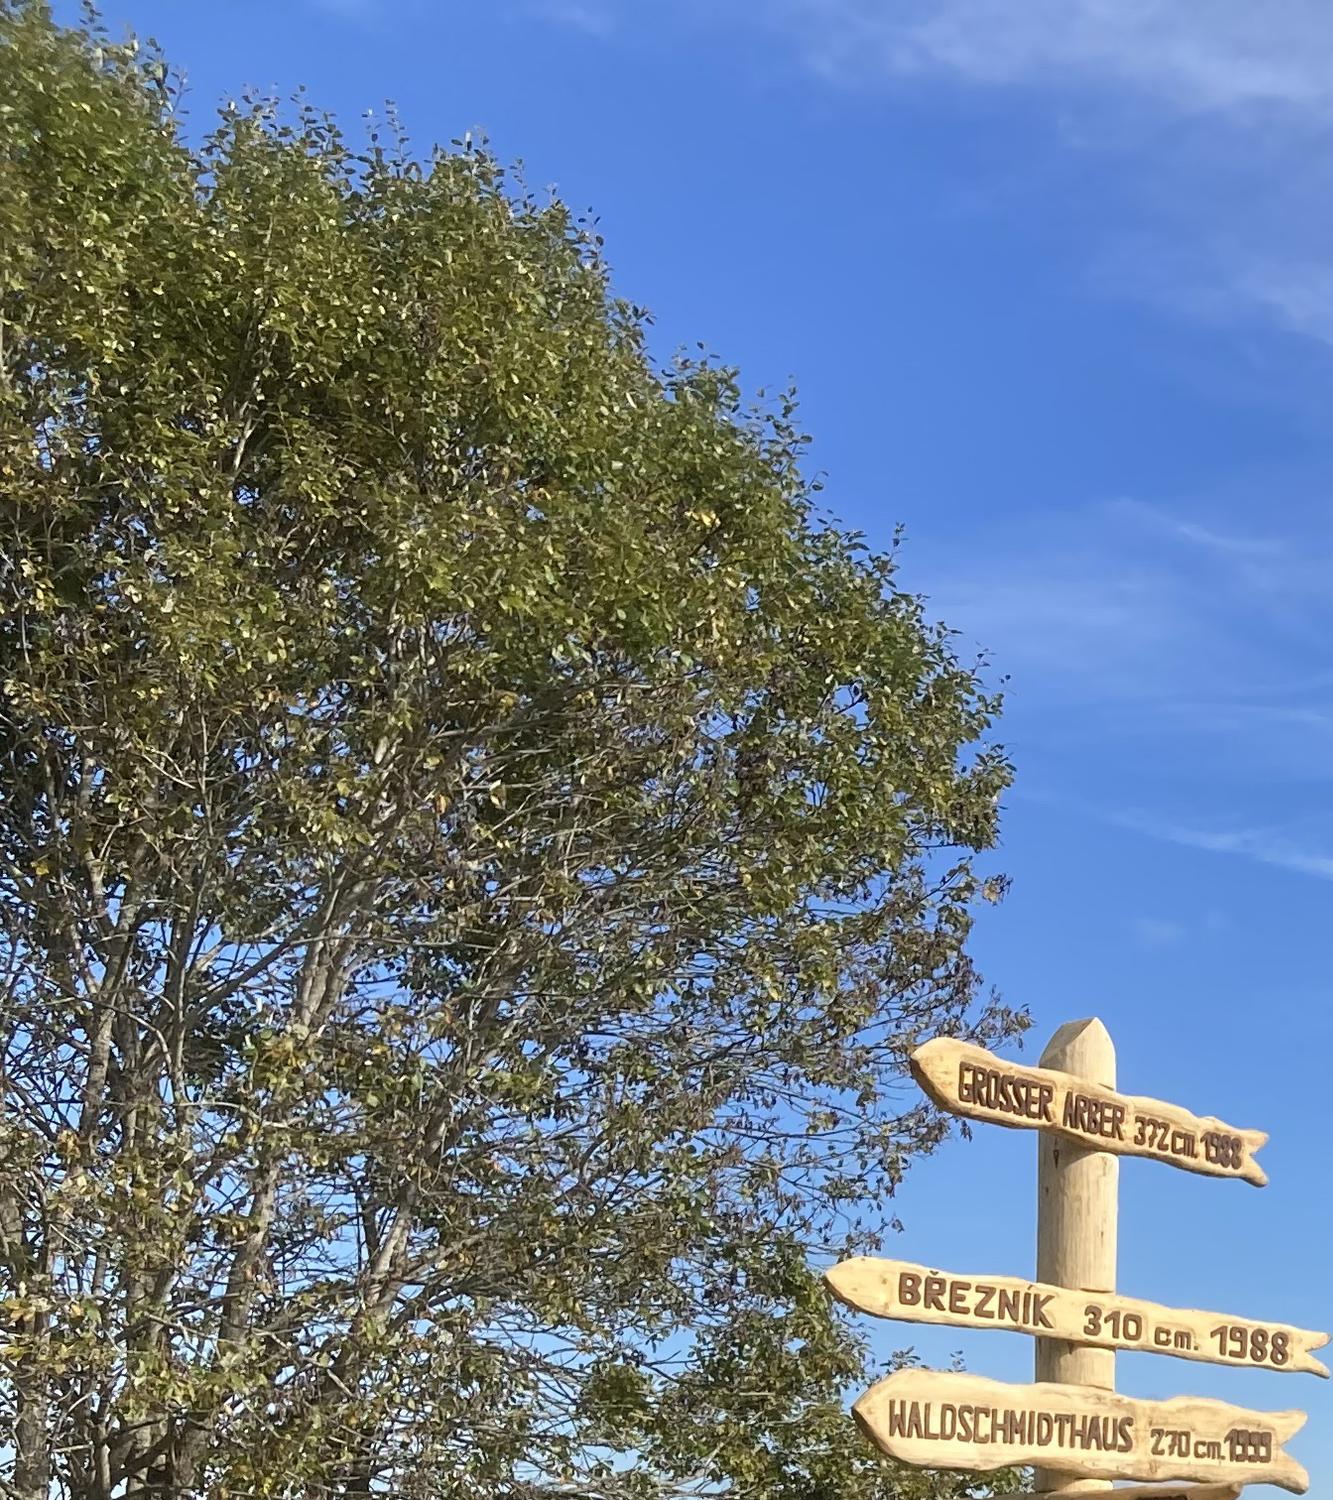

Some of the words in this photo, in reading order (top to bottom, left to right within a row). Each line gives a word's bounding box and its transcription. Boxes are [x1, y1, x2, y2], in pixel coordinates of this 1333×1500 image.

[958, 1061, 1054, 1122] GROSSER
[1063, 1090, 1126, 1141] ARBER
[1200, 1131, 1242, 1170] 1988
[898, 1270, 1055, 1329] BŘEZNÍK
[1083, 1305, 1143, 1341] 310
[1154, 1326, 1200, 1351] cm.
[1210, 1325, 1290, 1366] 1988
[888, 1399, 1134, 1453] WALDSCHMIDTHAUS
[1150, 1428, 1191, 1458] 270
